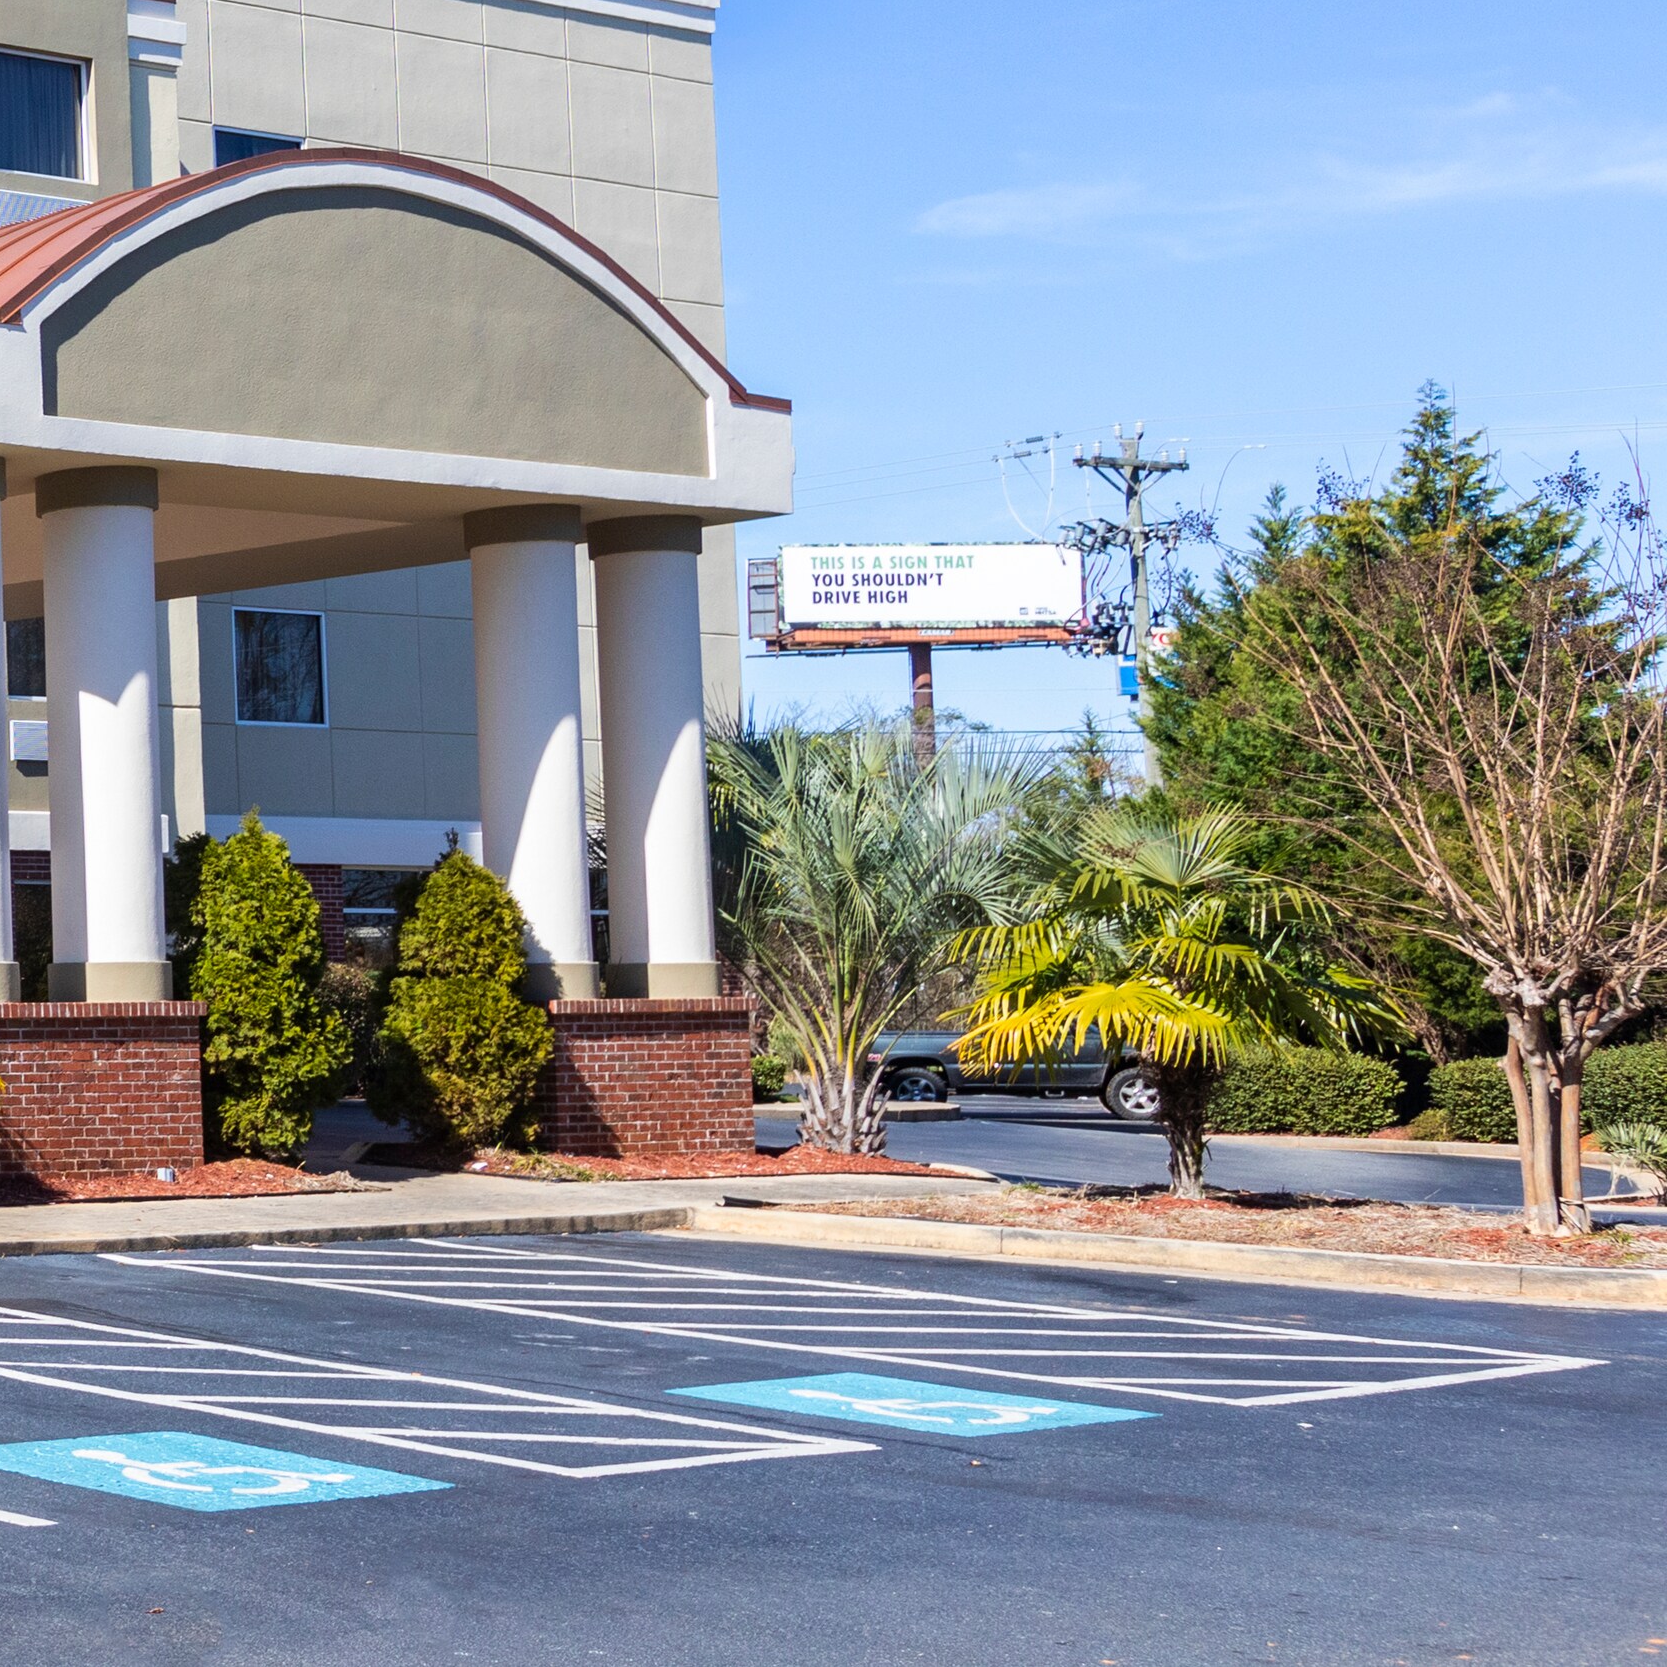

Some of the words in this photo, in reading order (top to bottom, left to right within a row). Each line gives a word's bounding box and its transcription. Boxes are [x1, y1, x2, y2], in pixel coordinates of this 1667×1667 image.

[811, 556, 844, 569] THIS
[852, 556, 865, 569] IS
[872, 556, 883, 569] A
[889, 555, 928, 569] SIGN
[934, 555, 974, 569] THAT
[812, 573, 845, 587] YOU
[852, 573, 944, 586] SHOULDN'T
[812, 591, 861, 604] DRIVE
[868, 590, 908, 604] HIGH
